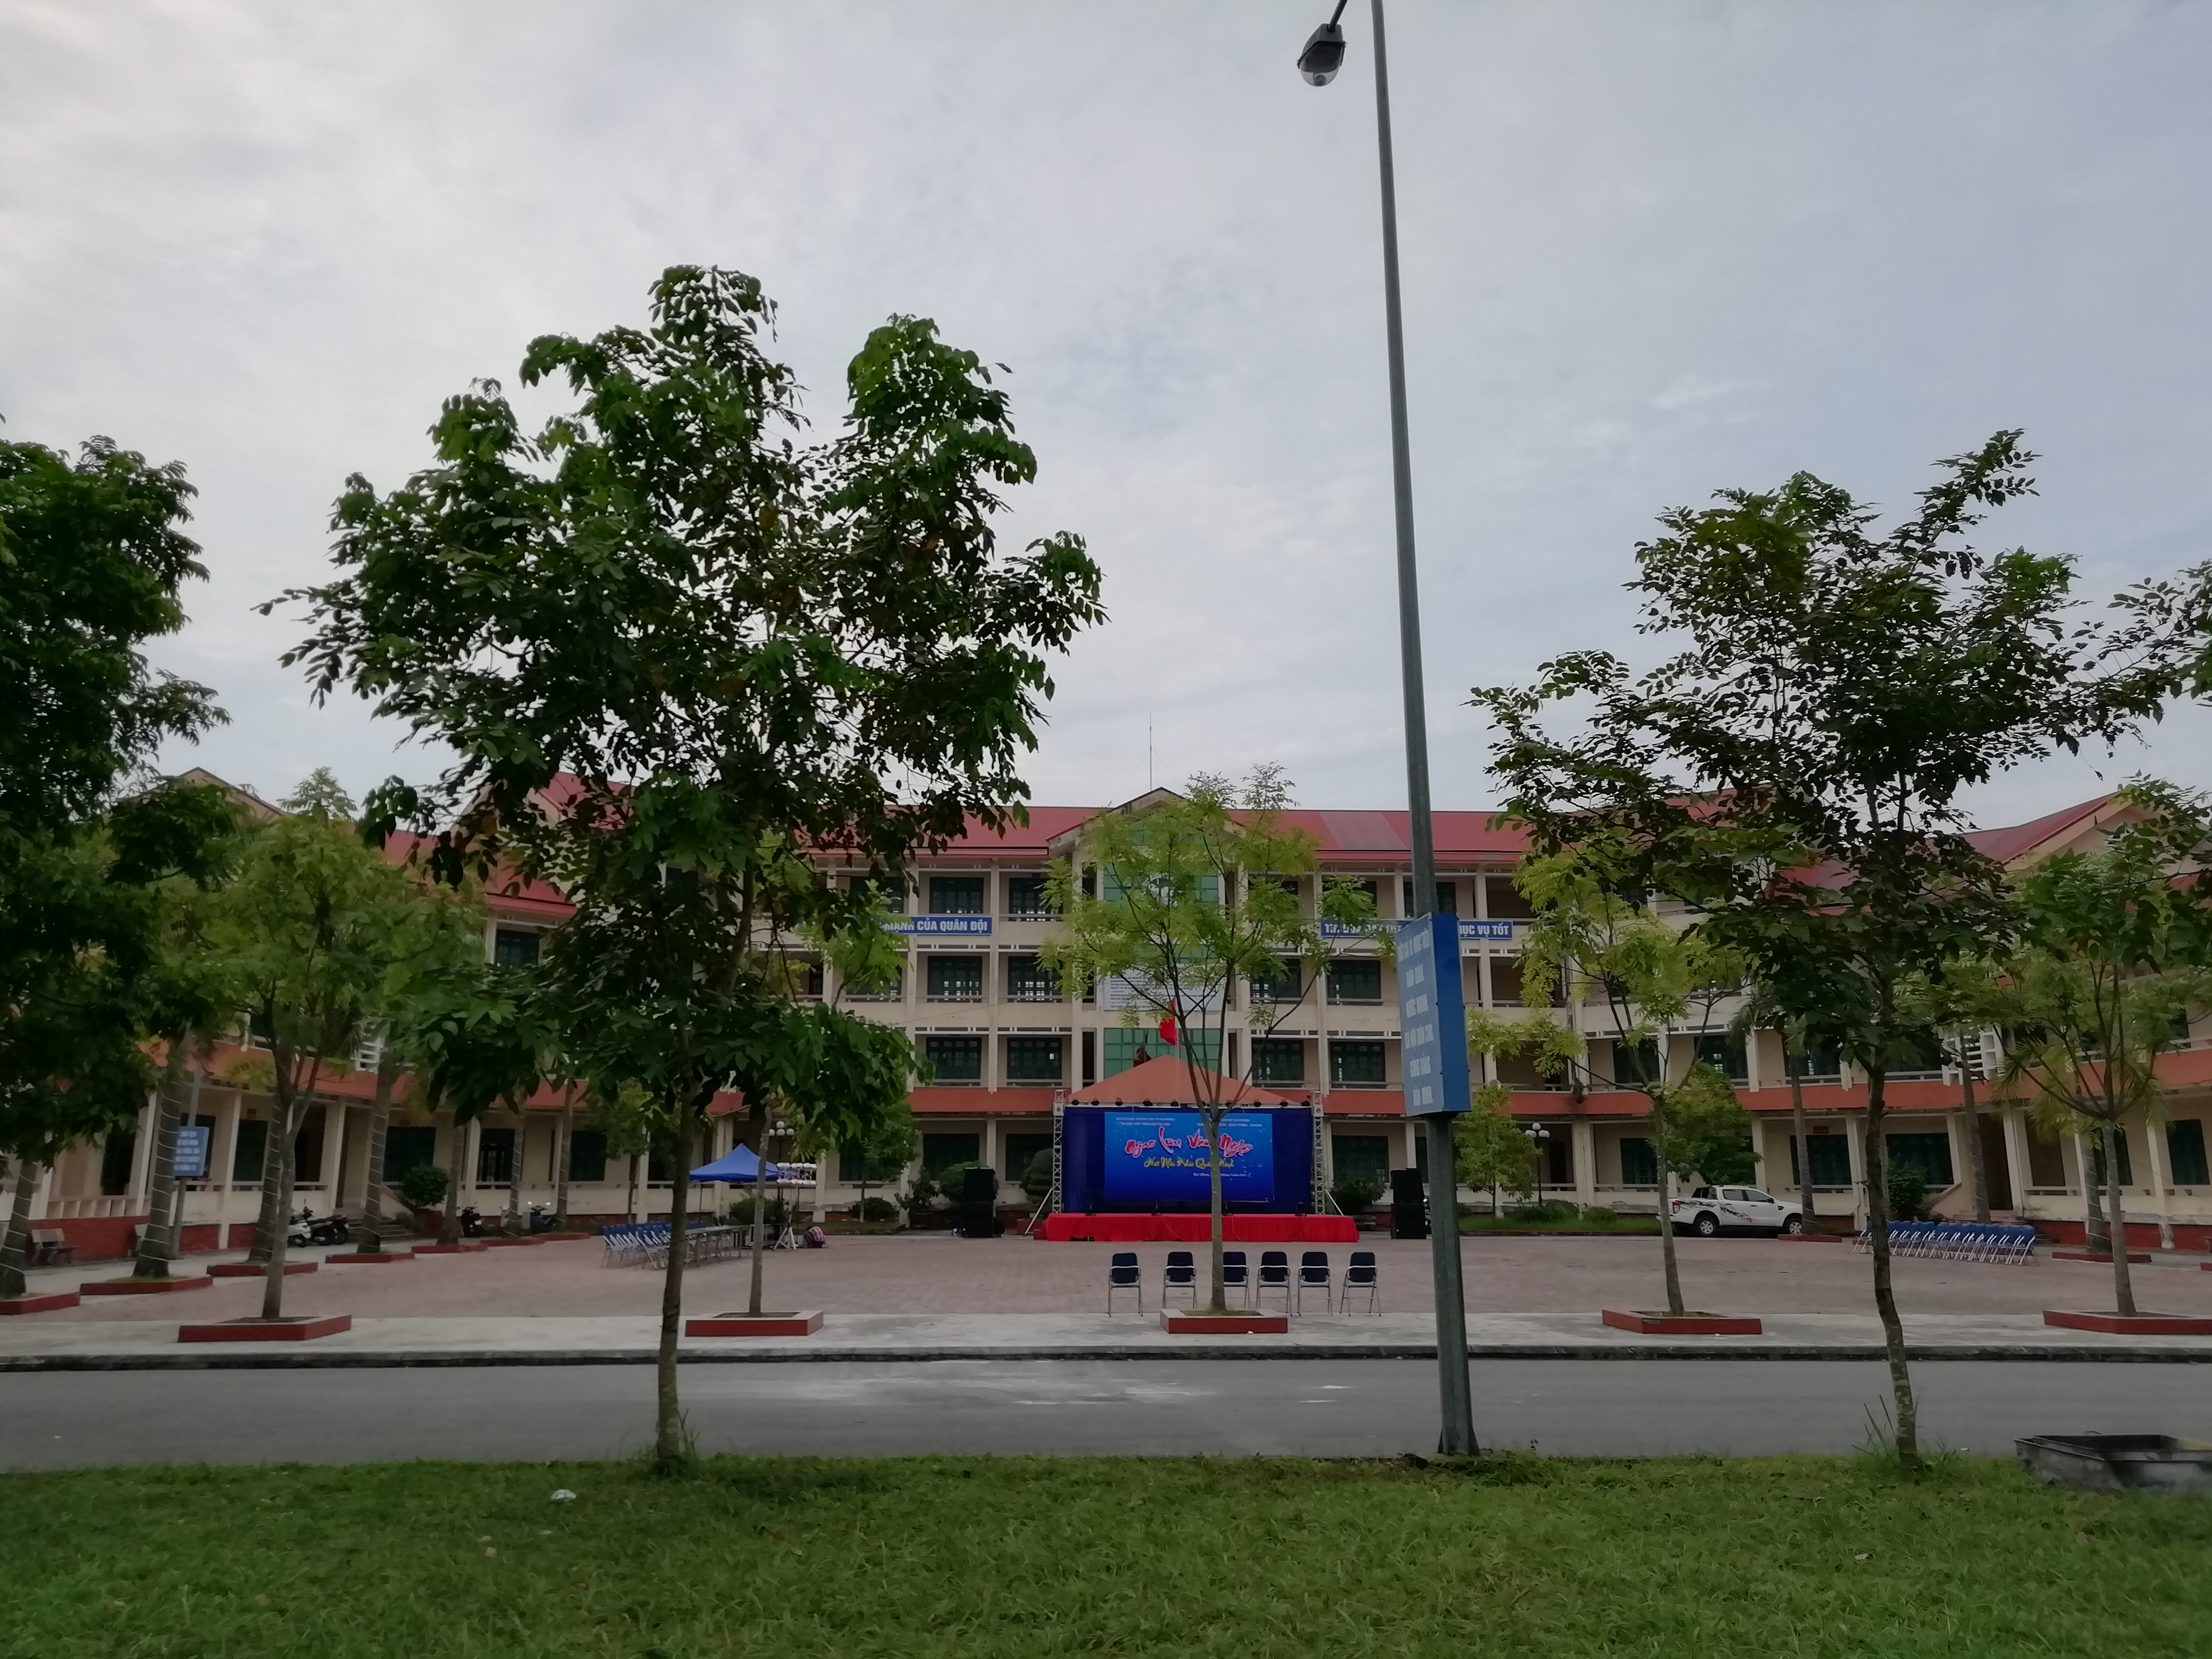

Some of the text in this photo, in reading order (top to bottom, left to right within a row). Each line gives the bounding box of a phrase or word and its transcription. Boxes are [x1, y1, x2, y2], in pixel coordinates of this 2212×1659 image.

[917, 918, 937, 931] CỦA
[940, 919, 968, 932] QUÂN
[970, 919, 987, 933] ĐỘI
[1477, 925, 1489, 937] VỤ
[1492, 922, 1509, 935] TỐT
